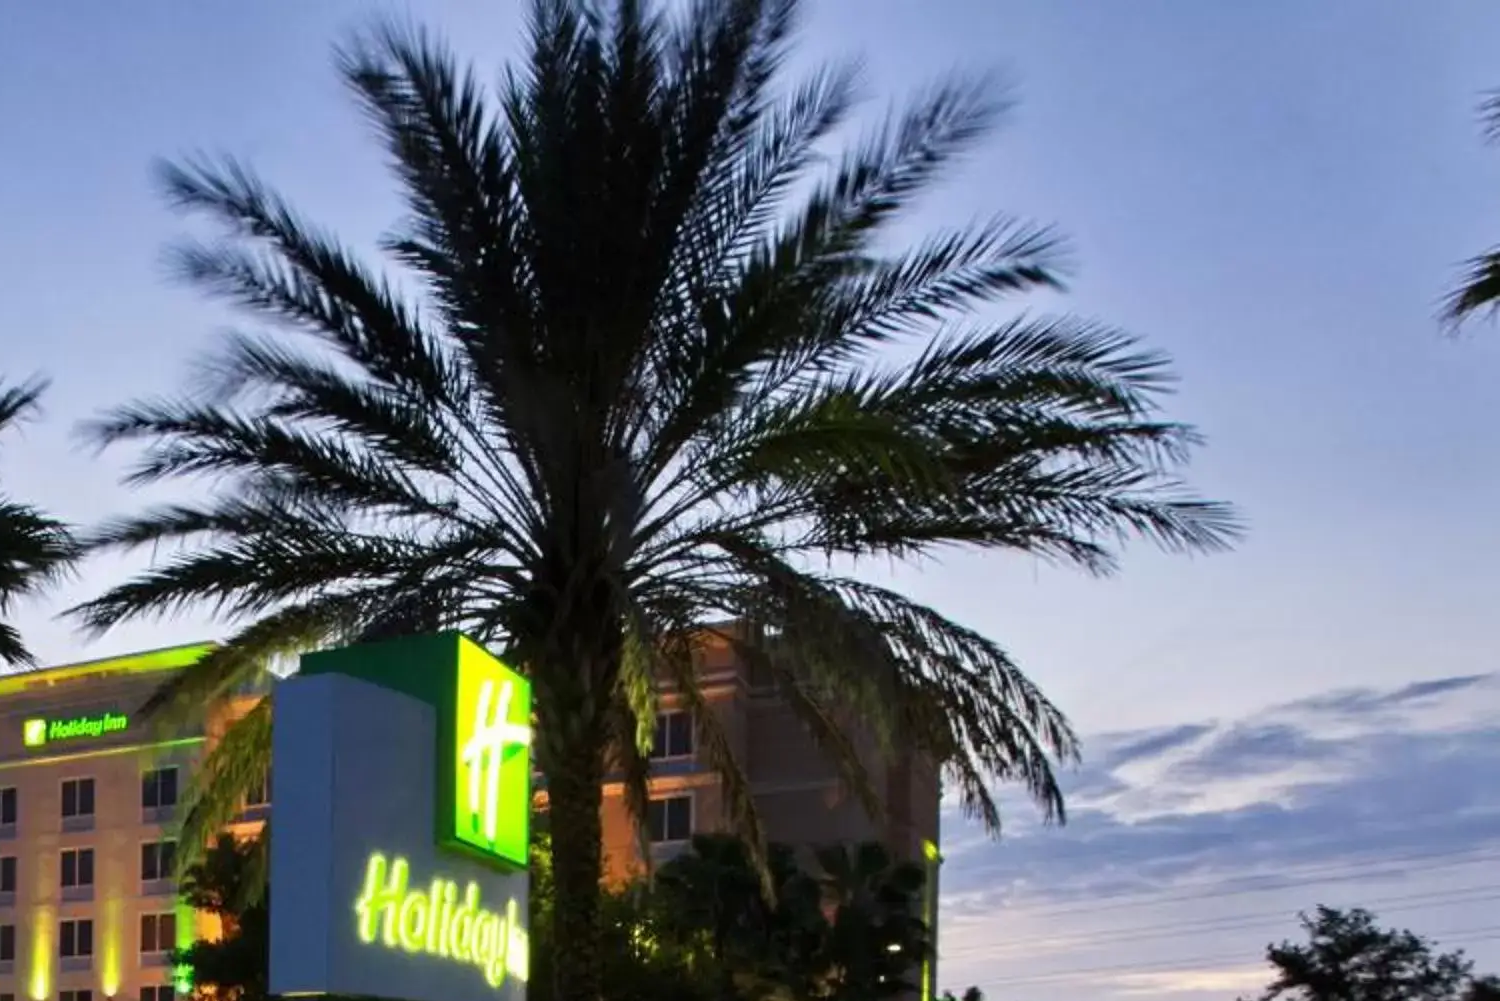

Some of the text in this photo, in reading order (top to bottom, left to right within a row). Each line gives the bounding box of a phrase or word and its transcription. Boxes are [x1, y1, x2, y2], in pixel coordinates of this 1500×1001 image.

[49, 712, 127, 739] Holiday Inn
[356, 852, 507, 988] Holiday
